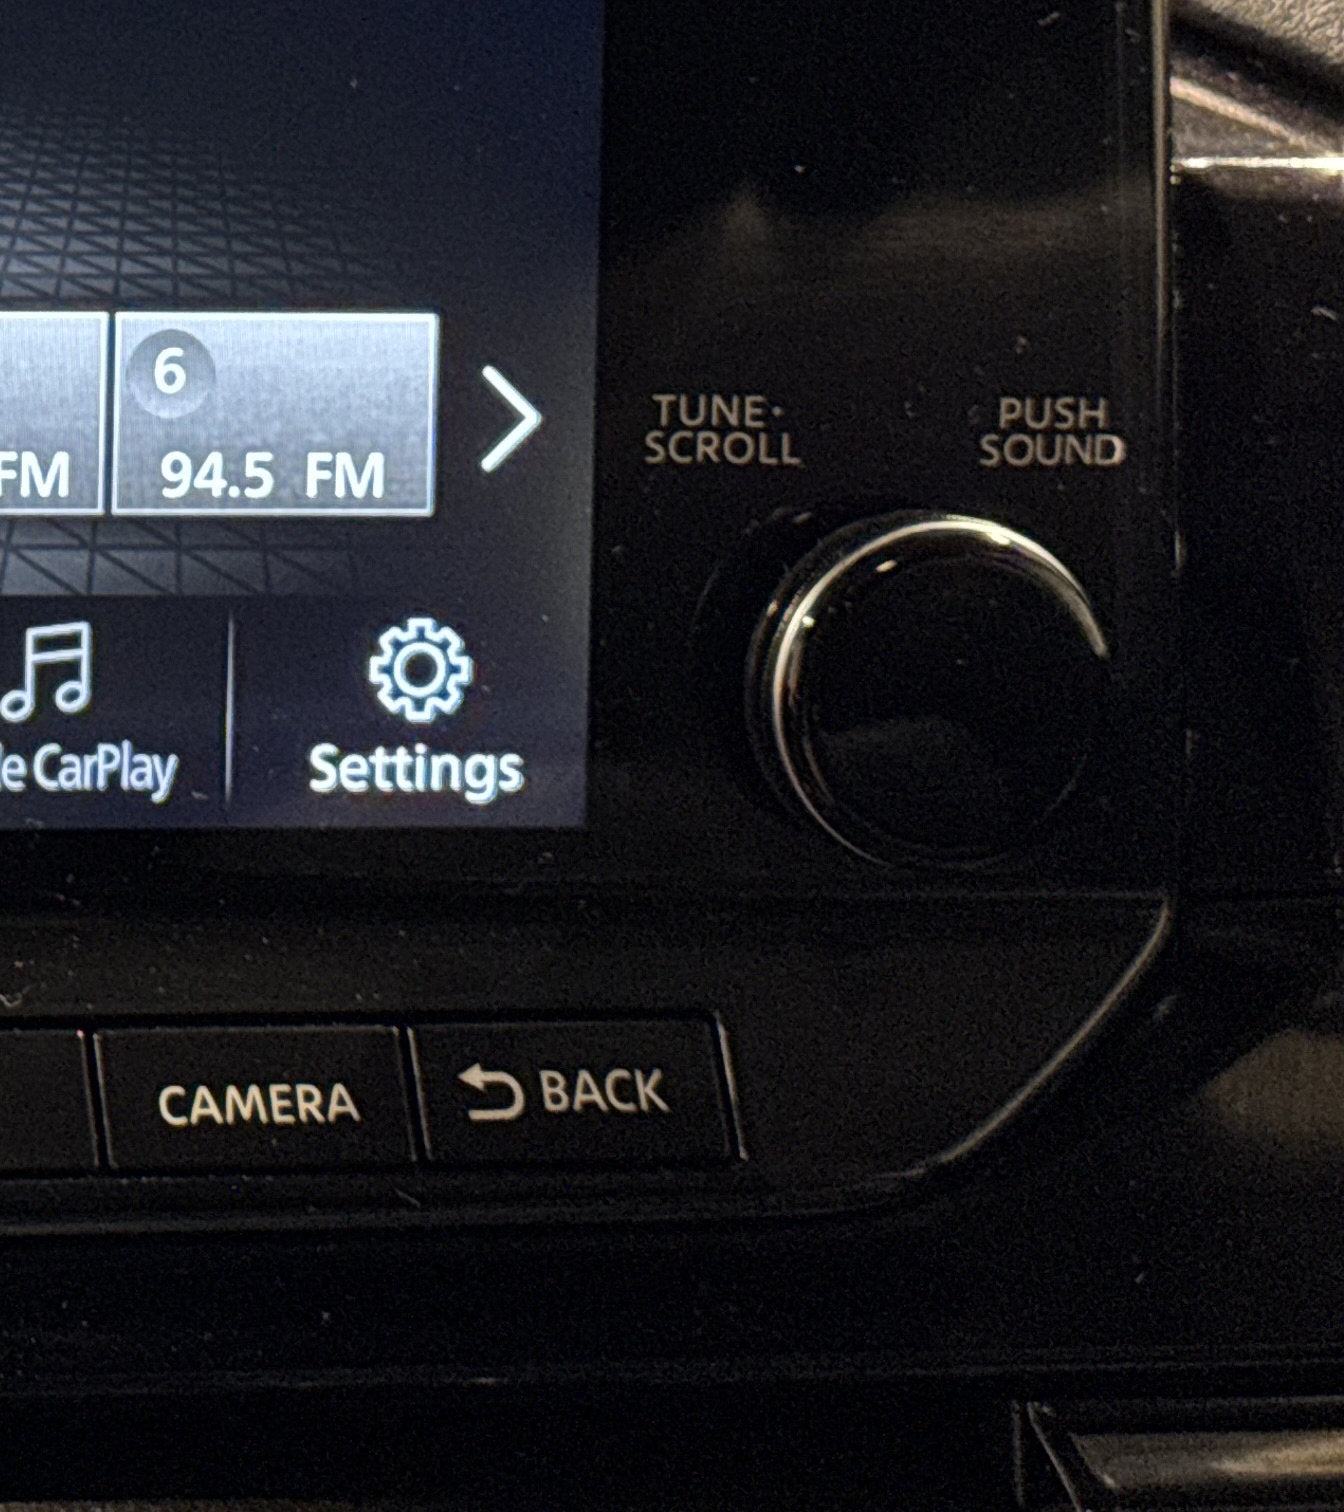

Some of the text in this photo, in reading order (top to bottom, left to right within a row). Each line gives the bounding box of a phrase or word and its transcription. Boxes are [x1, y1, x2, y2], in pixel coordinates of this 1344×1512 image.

[152, 346, 187, 395] 6
[999, 396, 1109, 431] PUSH
[644, 430, 803, 467] SCROLL
[979, 433, 1128, 468] SOUND
[159, 451, 386, 500] 94.5 FM
[32, 740, 179, 805] CarPlay
[309, 741, 525, 806] Settings
[157, 1082, 362, 1127] CAMERA
[537, 1068, 672, 1114] BACK
